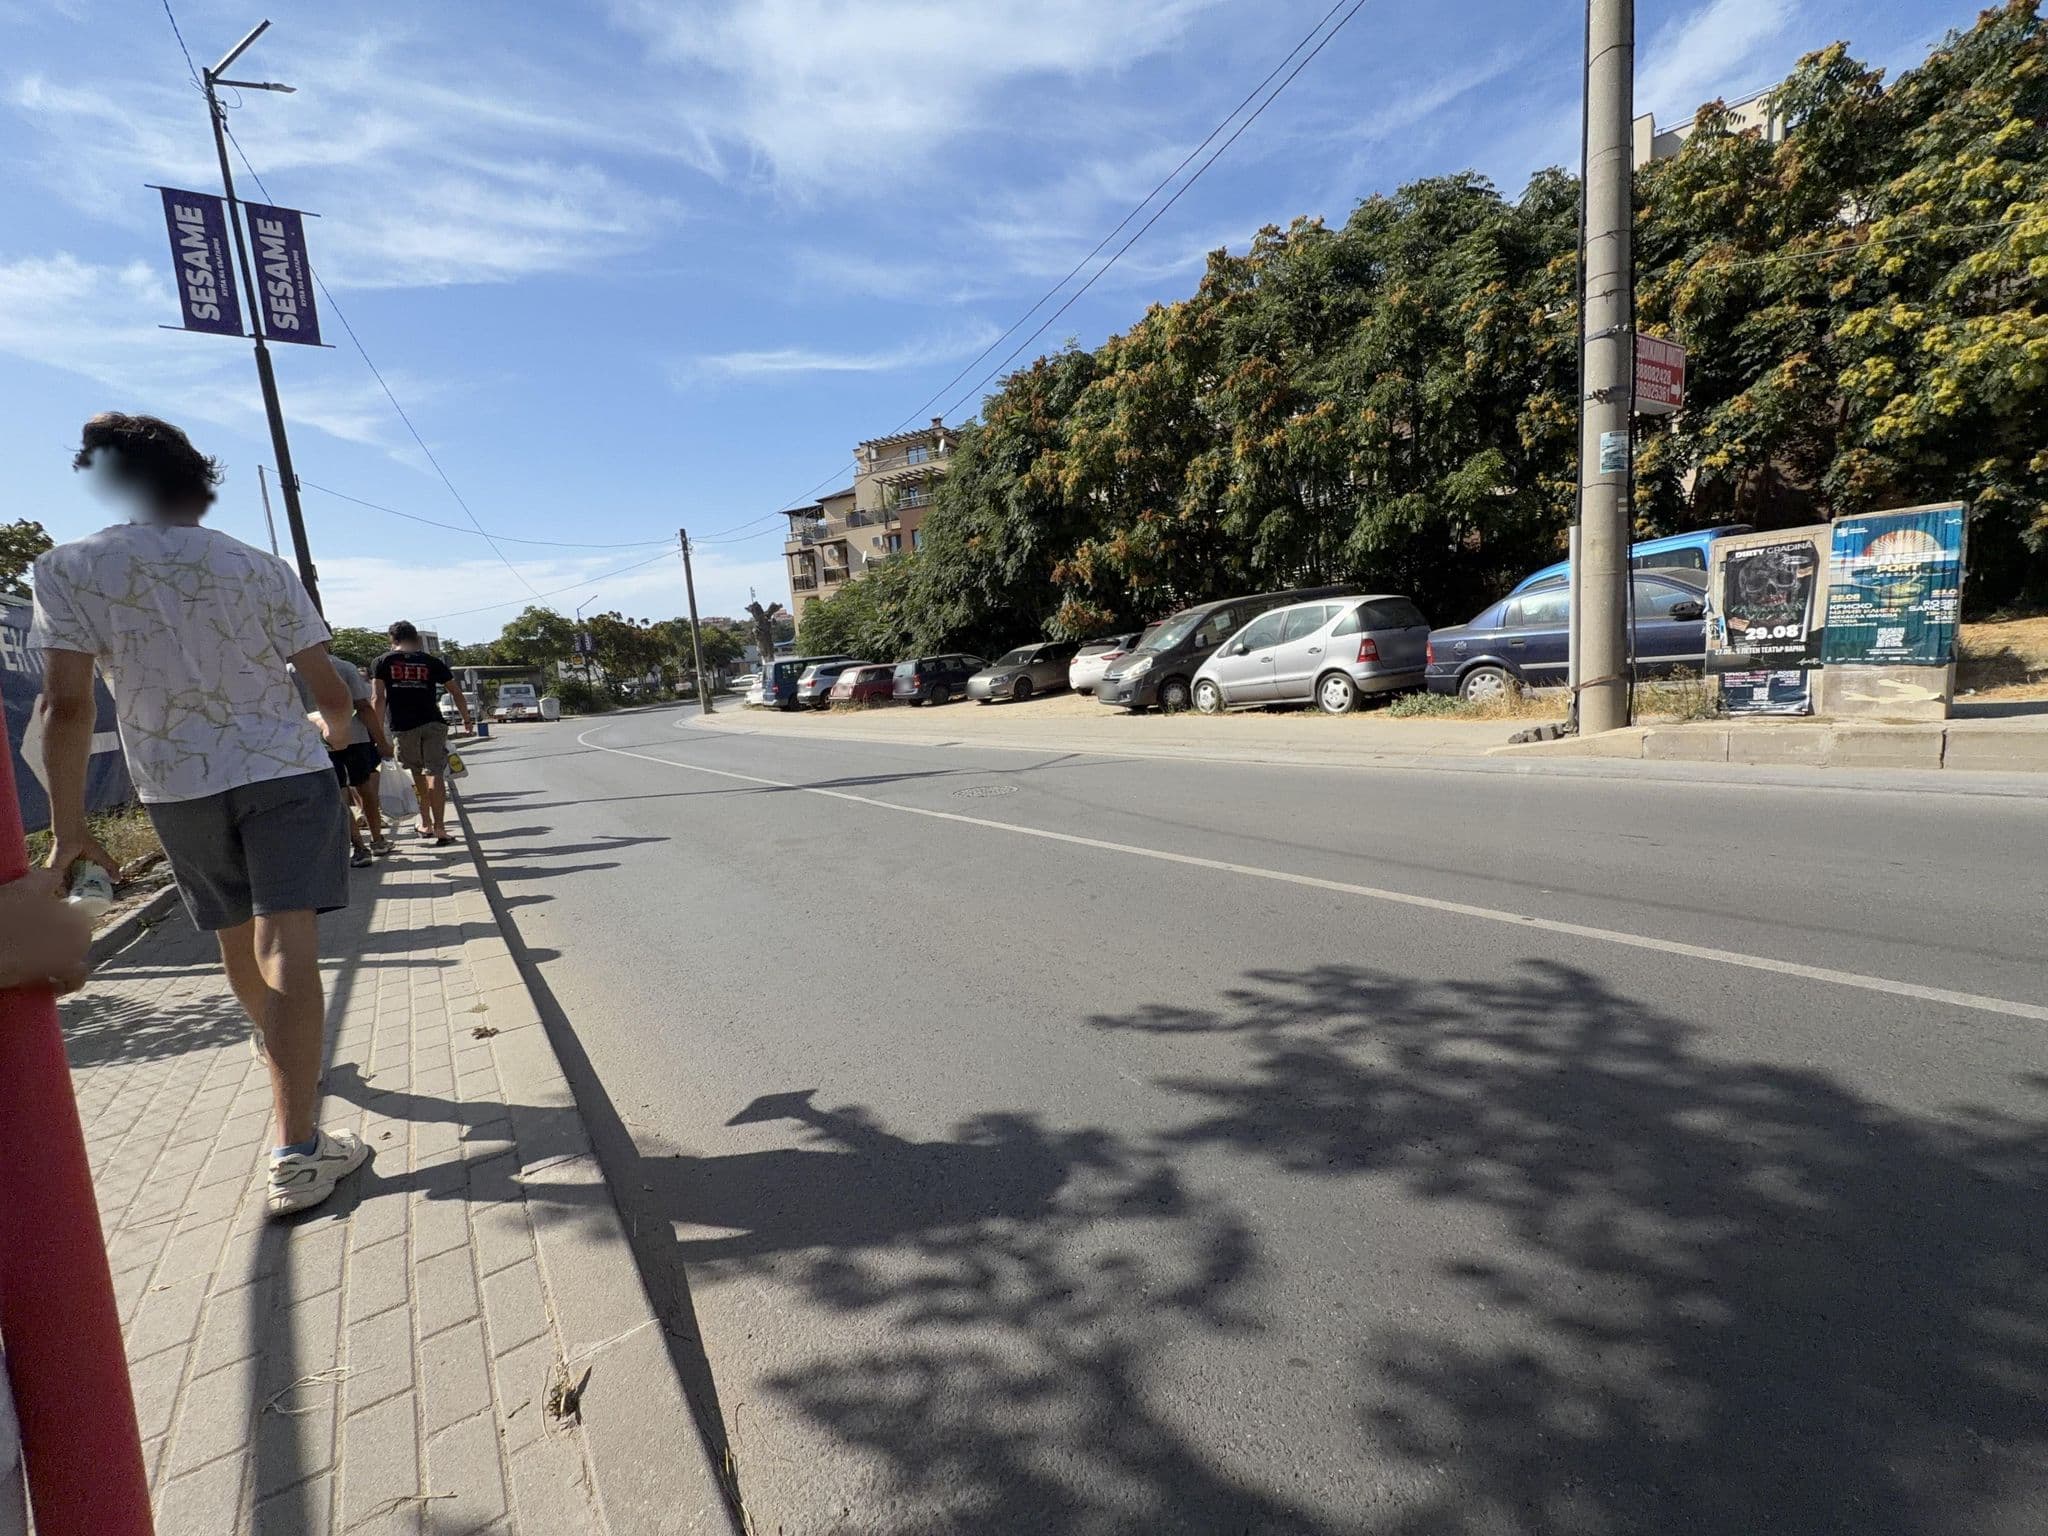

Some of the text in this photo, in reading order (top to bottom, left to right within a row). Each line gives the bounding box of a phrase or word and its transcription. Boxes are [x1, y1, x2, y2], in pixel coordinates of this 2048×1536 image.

[174, 204, 221, 322] SESAME
[256, 218, 299, 331] SESAME
[1735, 548, 1766, 559] DIRTY
[1876, 562, 1920, 573] PORT
[1829, 602, 1874, 610] КРИСКО
[1745, 624, 1799, 641] 29.08
